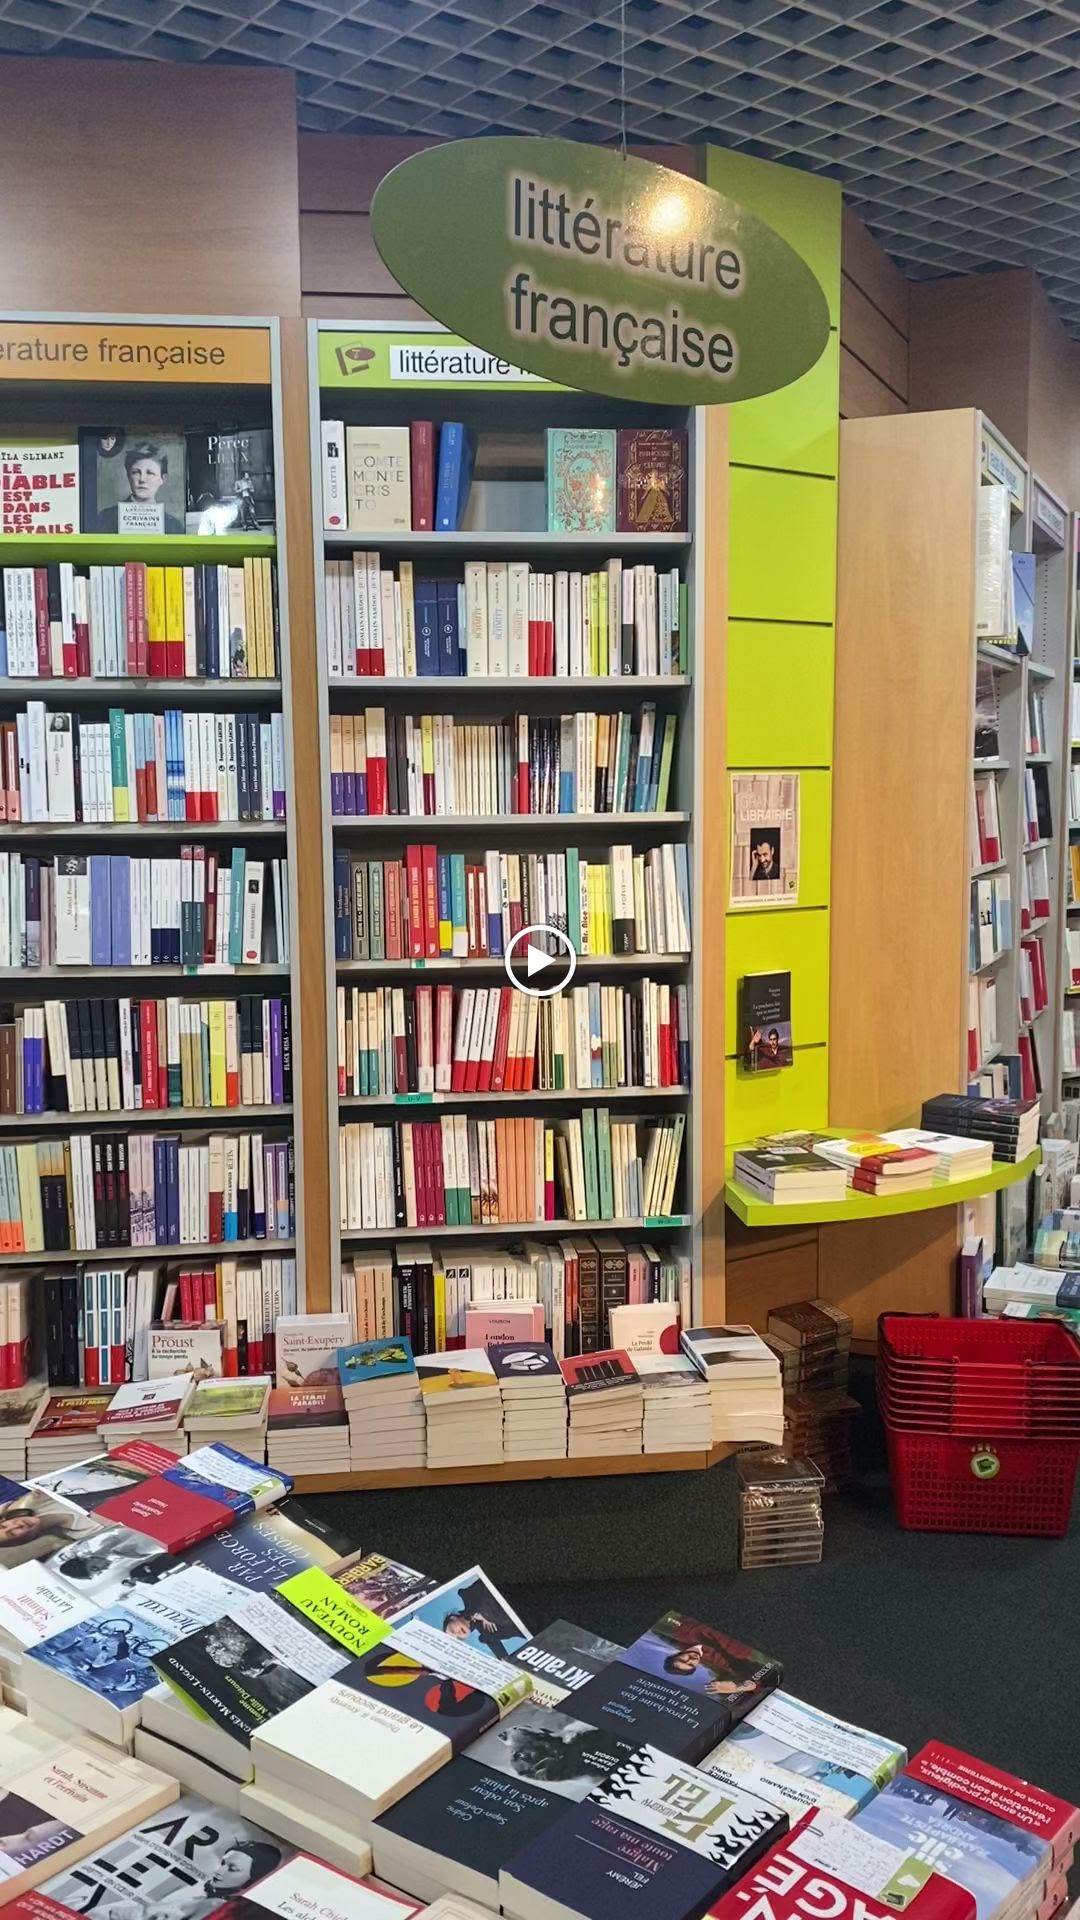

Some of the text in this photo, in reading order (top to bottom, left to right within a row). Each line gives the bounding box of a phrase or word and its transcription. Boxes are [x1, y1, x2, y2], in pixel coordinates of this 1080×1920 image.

[514, 178, 741, 290] littérature
[510, 273, 733, 373] française
[0, 337, 225, 370] rature française
[399, 349, 510, 375] littérature
[208, 435, 249, 449] Perec
[22, 451, 65, 461] SLIMANI
[353, 455, 403, 468] COMTE
[3, 463, 22, 474] LE
[353, 470, 405, 483] MONTE
[0, 473, 76, 490] IABLE
[3, 491, 32, 502] EST
[354, 498, 377, 511] TO
[3, 502, 51, 513] DANS
[3, 514, 32, 525] LES
[3, 522, 74, 534] DÉTAILS
[740, 808, 792, 821] LIBRAIRIE
[152, 1334, 195, 1348] Proust
[282, 1334, 345, 1348] Saint-Exupéry
[485, 1333, 515, 1341] London
[252, 1521, 310, 1560] CHOSES
[213, 1530, 287, 1581] LA FORCE
[263, 1549, 296, 1568] DES
[228, 1562, 262, 1583] PAR
[301, 1598, 366, 1649] NOUVEAU
[320, 1596, 370, 1636] ROMAN
[168, 1657, 236, 1720] MARTIN-LUGAND
[224, 1675, 257, 1703] Détours
[629, 1684, 667, 1701] mordras
[636, 1677, 681, 1697] poussière
[239, 1698, 266, 1724] Homme
[337, 1688, 425, 1734] Le grand secours
[621, 1690, 700, 1729] La prochaine fois
[680, 1704, 699, 1716] que
[594, 1750, 620, 1765] DUBOIS
[712, 1765, 733, 1778] CARO
[920, 1765, 981, 1798] prodigieux,
[930, 1762, 971, 1785] comble.
[479, 1776, 511, 1795] pluie
[759, 1777, 817, 1804] D'UN SCÉNARIO
[958, 1765, 1056, 1813] OLIVIA DE LAMBERTERIE
[970, 1781, 990, 1796] son
[469, 1783, 525, 1813] Son odeur
[521, 1792, 550, 1810] après
[780, 1789, 813, 1806] JOURNAL
[980, 1795, 1017, 1815] amour
[446, 1805, 472, 1821] Cédric
[999, 1794, 1051, 1825] l'émotion
[14, 1829, 74, 1865] HARDT
[591, 1816, 673, 1861] toute ma rage
[908, 1831, 966, 1864] elle
[617, 1846, 664, 1873] Malgré
[605, 1869, 643, 1890] JÉRÉMY
[634, 1871, 649, 1884] FEL
[277, 1900, 294, 1915] Les
[289, 1891, 319, 1912] Sarah
